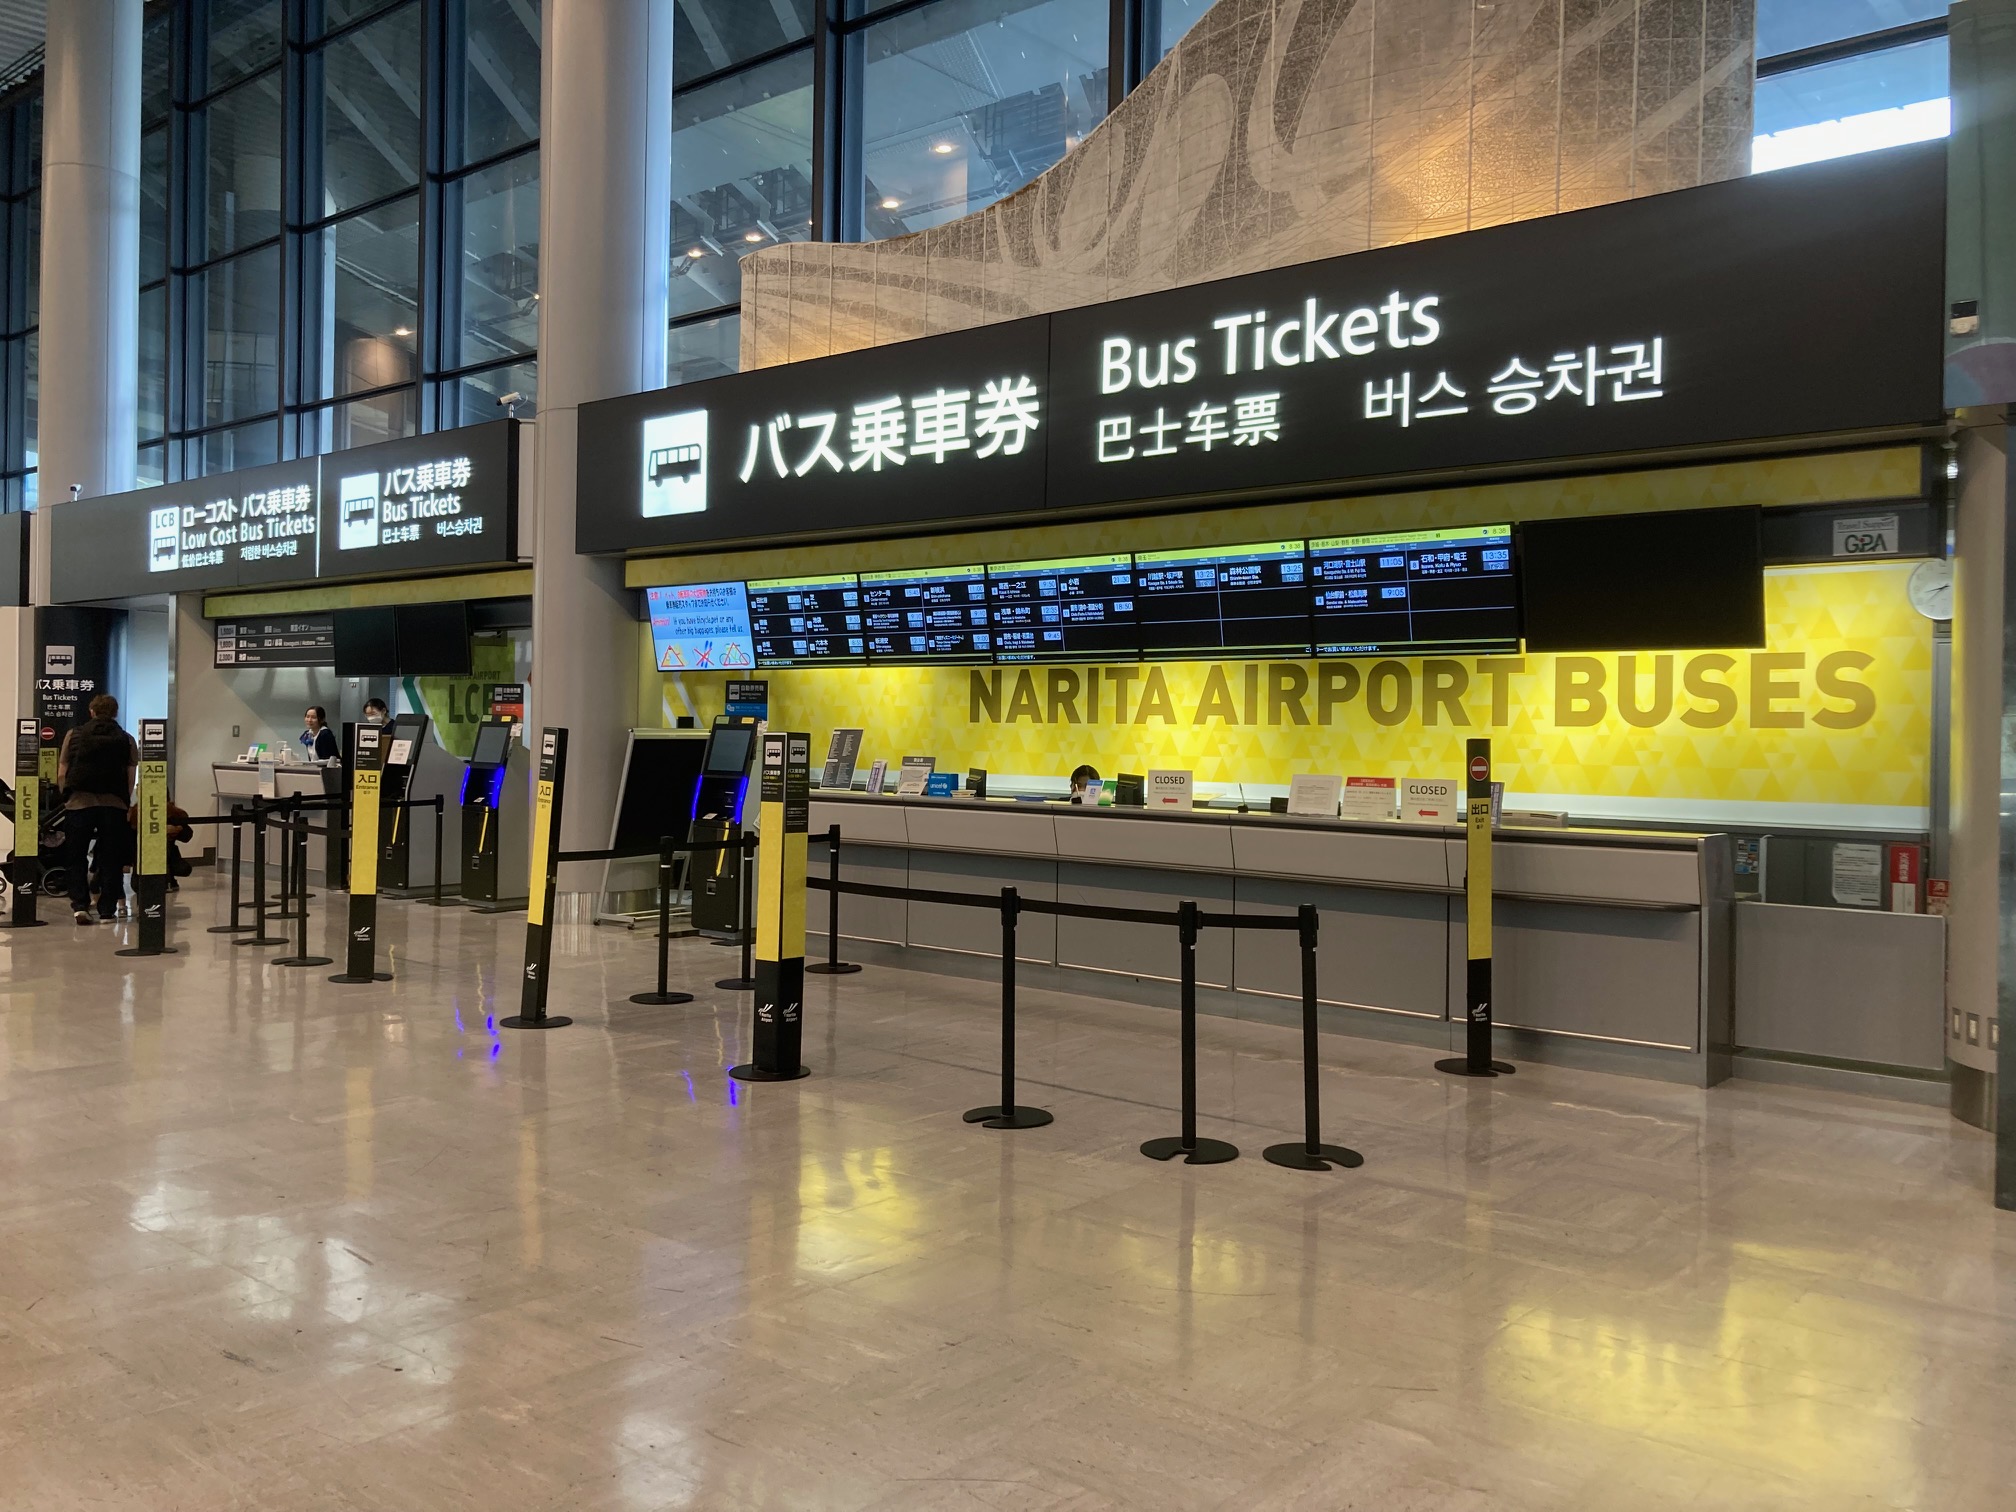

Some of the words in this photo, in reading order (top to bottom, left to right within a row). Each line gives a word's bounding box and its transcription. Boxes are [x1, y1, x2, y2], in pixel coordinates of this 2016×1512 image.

[1101, 337, 1196, 395] Bus
[1213, 290, 1441, 375] Tickets
[1364, 370, 1469, 428] 버스
[1487, 336, 1664, 416] 승차권
[739, 375, 1040, 484] バス乗車券
[1098, 392, 1281, 463] 巴士车票
[384, 457, 471, 497] バス乗車券
[182, 498, 238, 528] ローコスト
[241, 484, 311, 519] バス乗車券
[383, 501, 408, 523] Bus
[410, 493, 461, 519] Tickets
[155, 512, 175, 529] LCB
[182, 530, 207, 550] Low
[209, 525, 238, 546] Cost
[241, 521, 264, 542] Bus
[266, 514, 316, 539] Tickets
[382, 524, 420, 545] 巴士车票
[1844, 533, 1888, 554] GPA
[1381, 558, 1403, 567] 11:05
[1484, 551, 1507, 560] 13:35
[1196, 570, 1214, 578] 13:25
[1283, 565, 1302, 574] 13:25
[1387, 589, 1405, 597] 9:05
[35, 678, 95, 692] バス乗車券
[968, 666, 1178, 726] NARITA
[1192, 657, 1526, 727] AIRPORT
[1554, 650, 1877, 730] BUSES
[145, 765, 164, 773] 入口
[358, 774, 377, 783] 入口
[1154, 775, 1185, 785] CLOSED
[539, 785, 552, 796] 入口
[1409, 785, 1448, 796] CLOSED
[22, 785, 32, 820] LCB
[1471, 804, 1488, 815] 出口
[149, 795, 160, 835] LCB
